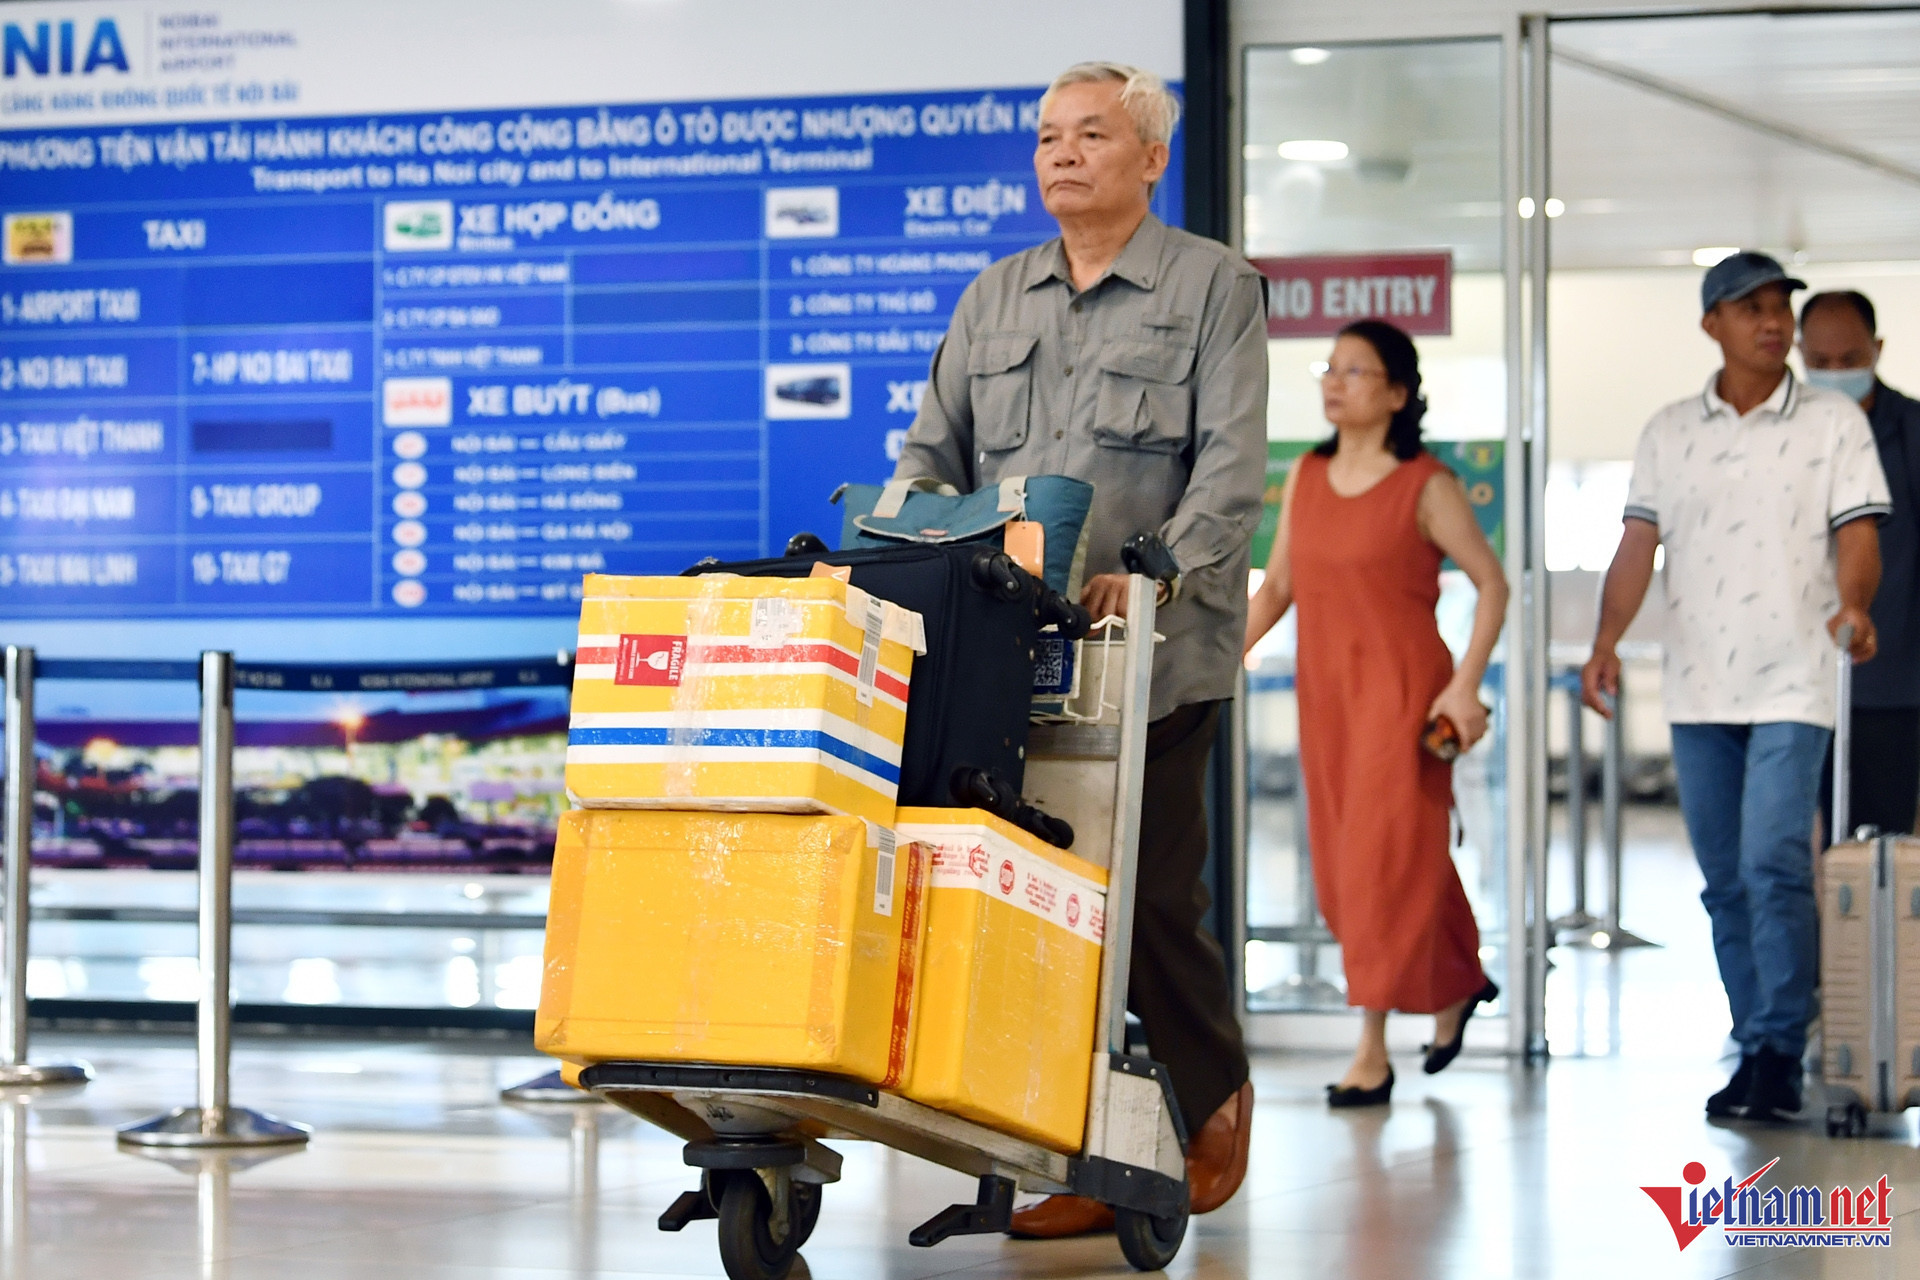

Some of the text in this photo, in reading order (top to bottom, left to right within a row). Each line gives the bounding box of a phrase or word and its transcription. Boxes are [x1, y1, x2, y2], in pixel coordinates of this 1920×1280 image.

[2, 18, 131, 78] NIA
[254, 122, 324, 160] HÀNH
[328, 119, 415, 157] KHÁCH
[420, 117, 492, 153] CÔNG
[656, 108, 677, 144] Ô
[683, 107, 717, 142] TÔ
[252, 147, 872, 193] Transport to Ha Noi city and to International Terminal
[459, 204, 499, 235] XE
[905, 187, 946, 217] XE
[144, 219, 206, 250] TAXI
[1267, 276, 1437, 318] NO ENTRY
[466, 386, 508, 417] XE
[512, 377, 593, 417] BUÝT
[666, 639, 684, 681] FRAGILE
